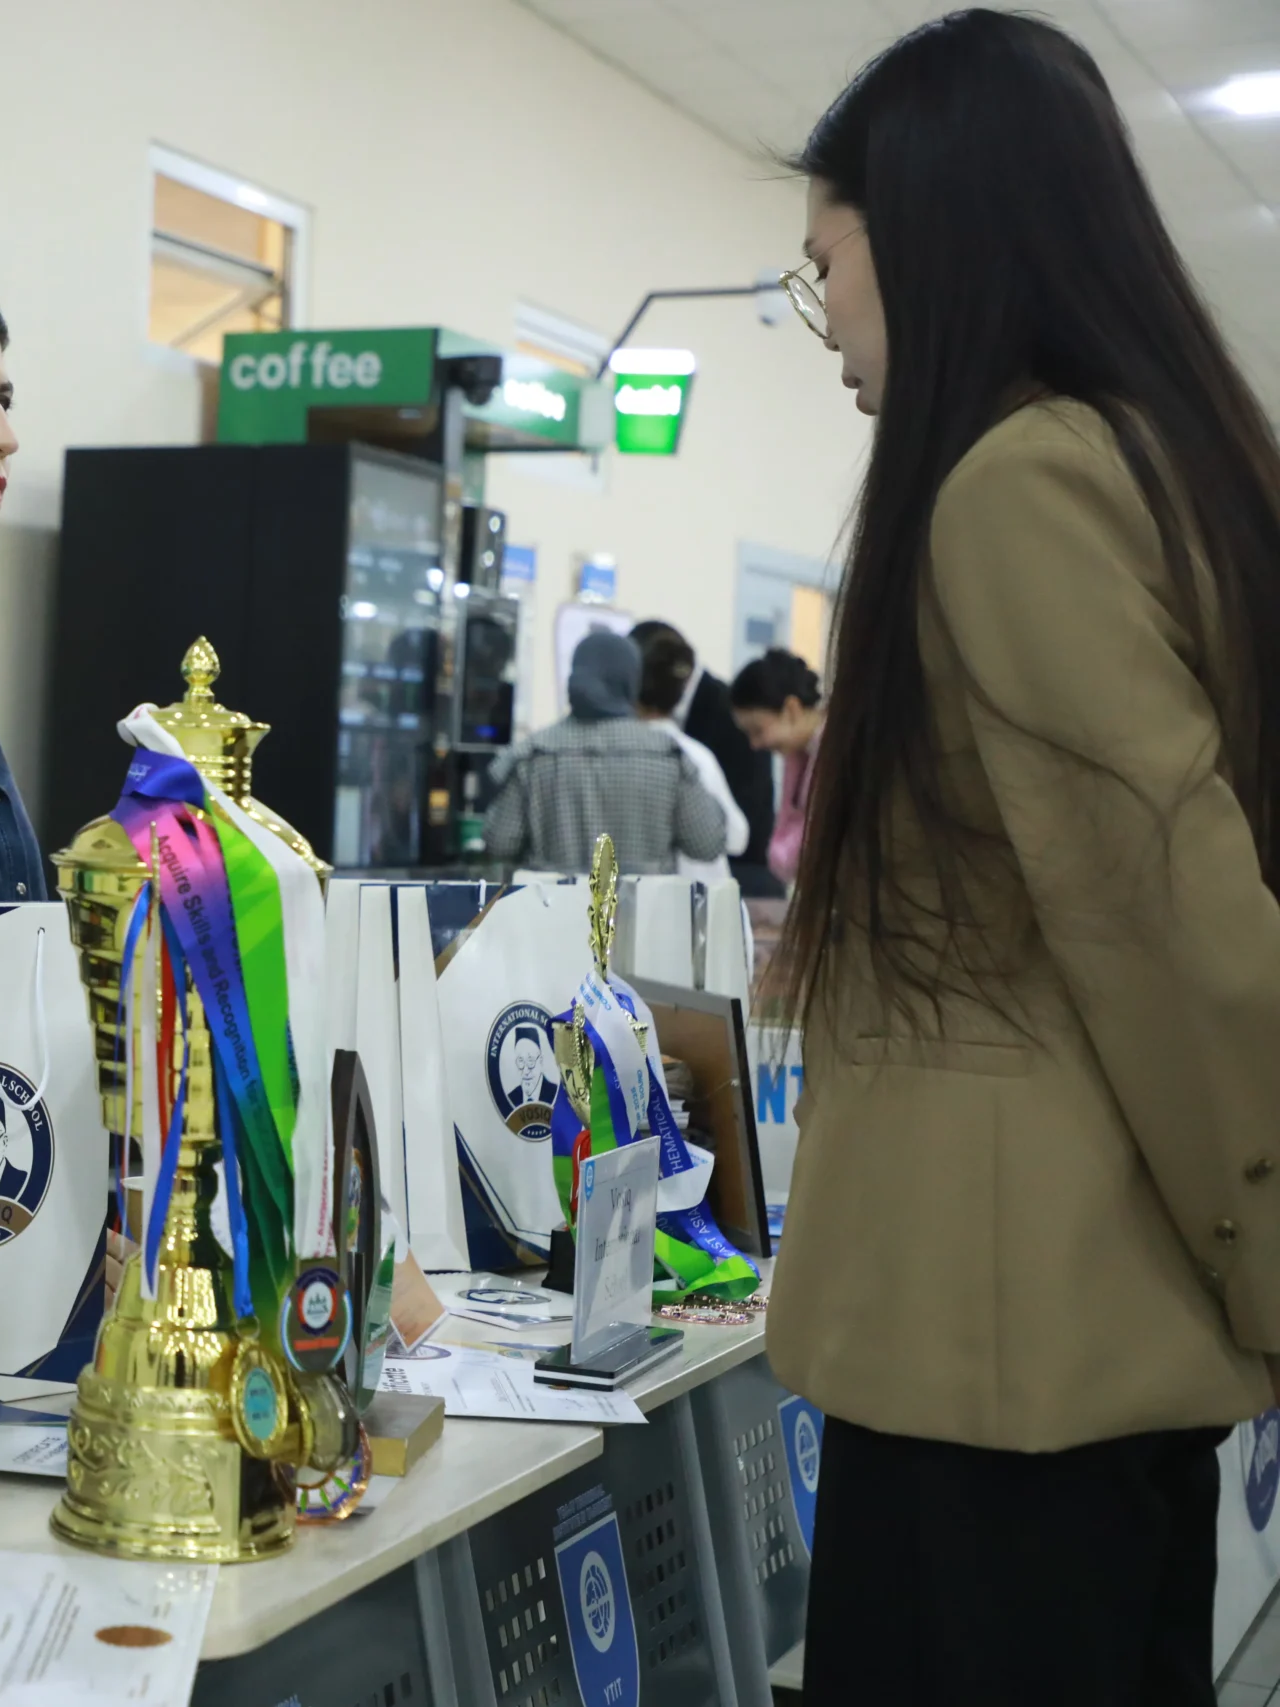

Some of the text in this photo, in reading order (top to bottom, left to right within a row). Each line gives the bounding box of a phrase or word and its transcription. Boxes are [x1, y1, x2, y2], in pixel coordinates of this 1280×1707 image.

[229, 341, 383, 391] coffee
[156, 834, 192, 896] Acquire
[183, 894, 211, 946] Skills
[201, 946, 225, 980] and
[216, 977, 250, 1081] Recognition
[490, 1008, 539, 1058] INTERNATIONAL
[603, 1676, 622, 1705] YTIT
